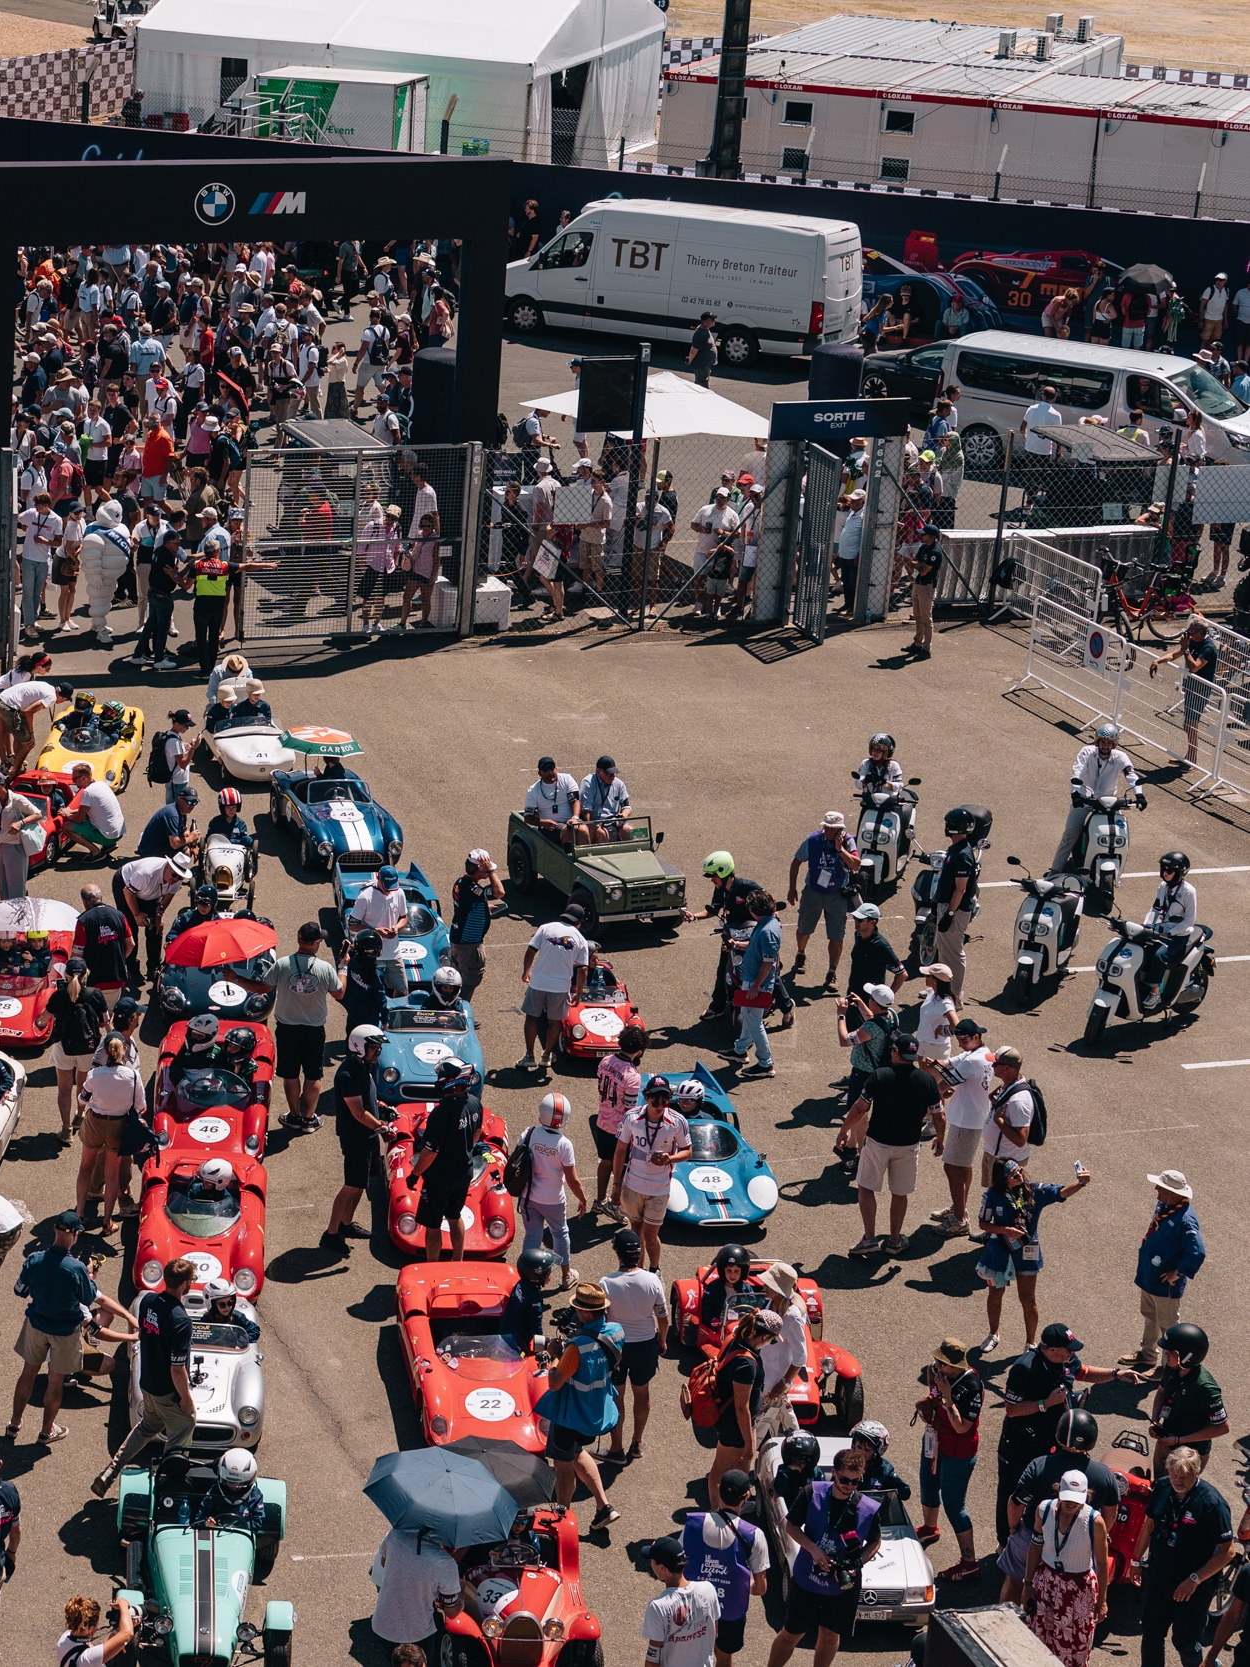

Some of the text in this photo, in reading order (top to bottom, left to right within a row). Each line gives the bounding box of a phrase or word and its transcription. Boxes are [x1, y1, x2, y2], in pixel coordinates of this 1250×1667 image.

[674, 75, 698, 83] LOXAM
[780, 84, 803, 92] LOXAM
[888, 93, 912, 101] LOXAM
[998, 102, 1023, 111] LOXAM
[1112, 112, 1138, 121] LOXAM
[1229, 122, 1250, 131] LOXA
[611, 237, 671, 272] TBT
[686, 254, 799, 278] Thierry Breton Traiteur
[839, 252, 855, 273] TBT
[704, 272, 725, 281] Depuis
[1007, 290, 1032, 307] 30
[642, 347, 651, 358] P
[813, 410, 867, 422] SORTIE
[830, 421, 848, 429] EXIT
[201, 567, 224, 576] CONTRÔLE
[319, 743, 354, 754] GARROS
[255, 751, 269, 759] 41
[339, 811, 356, 819] 44
[591, 1012, 607, 1022] 23
[425, 1048, 443, 1056] 21
[199, 1125, 220, 1133] 46
[635, 1135, 647, 1148] 10
[701, 1175, 722, 1184] 48
[479, 1399, 502, 1409] 22
[1117, 1512, 1128, 1523] 10
[700, 1563, 728, 1577] Legend
[482, 1589, 503, 1604] 33
